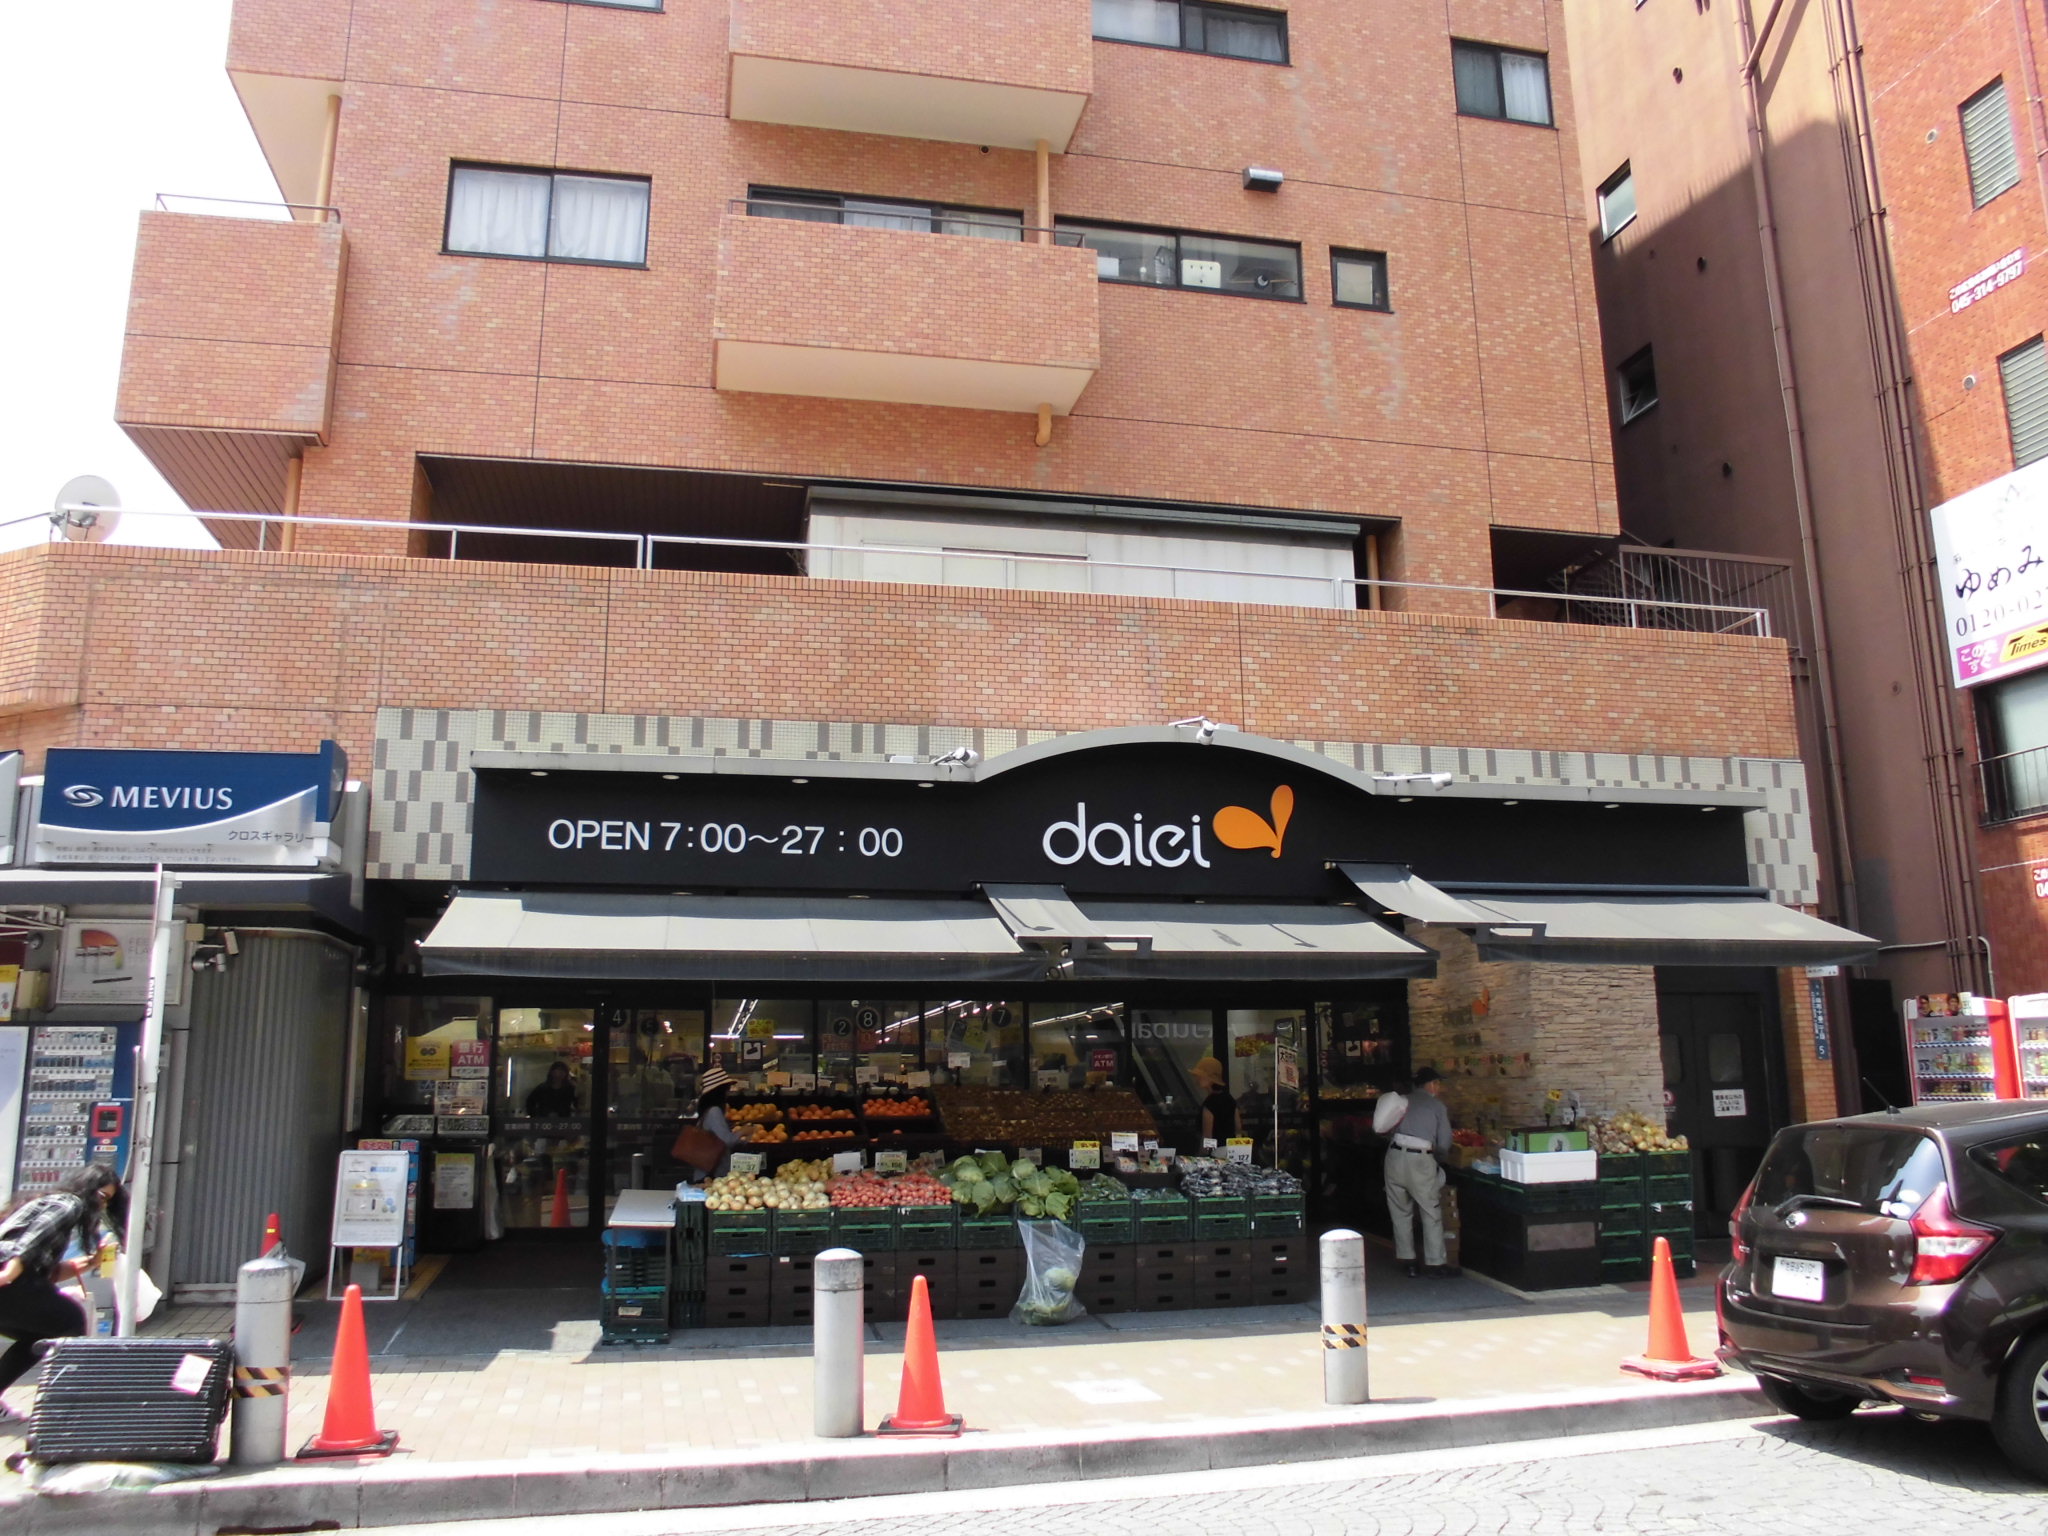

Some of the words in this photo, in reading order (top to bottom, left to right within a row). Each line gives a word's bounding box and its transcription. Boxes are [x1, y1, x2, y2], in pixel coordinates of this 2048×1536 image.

[1956, 586, 2048, 636] 0120-02
[2008, 632, 2047, 656] Times
[111, 786, 233, 810] MEVIUS
[228, 830, 313, 843] クロスギャラリー
[548, 818, 651, 851] OPEN
[1042, 801, 1211, 868] daiei
[863, 1011, 873, 1027] 8
[998, 1009, 1006, 1024] 7
[838, 1021, 846, 1036] 2
[458, 1054, 485, 1065] ATM
[1093, 1060, 1115, 1068] ATM
